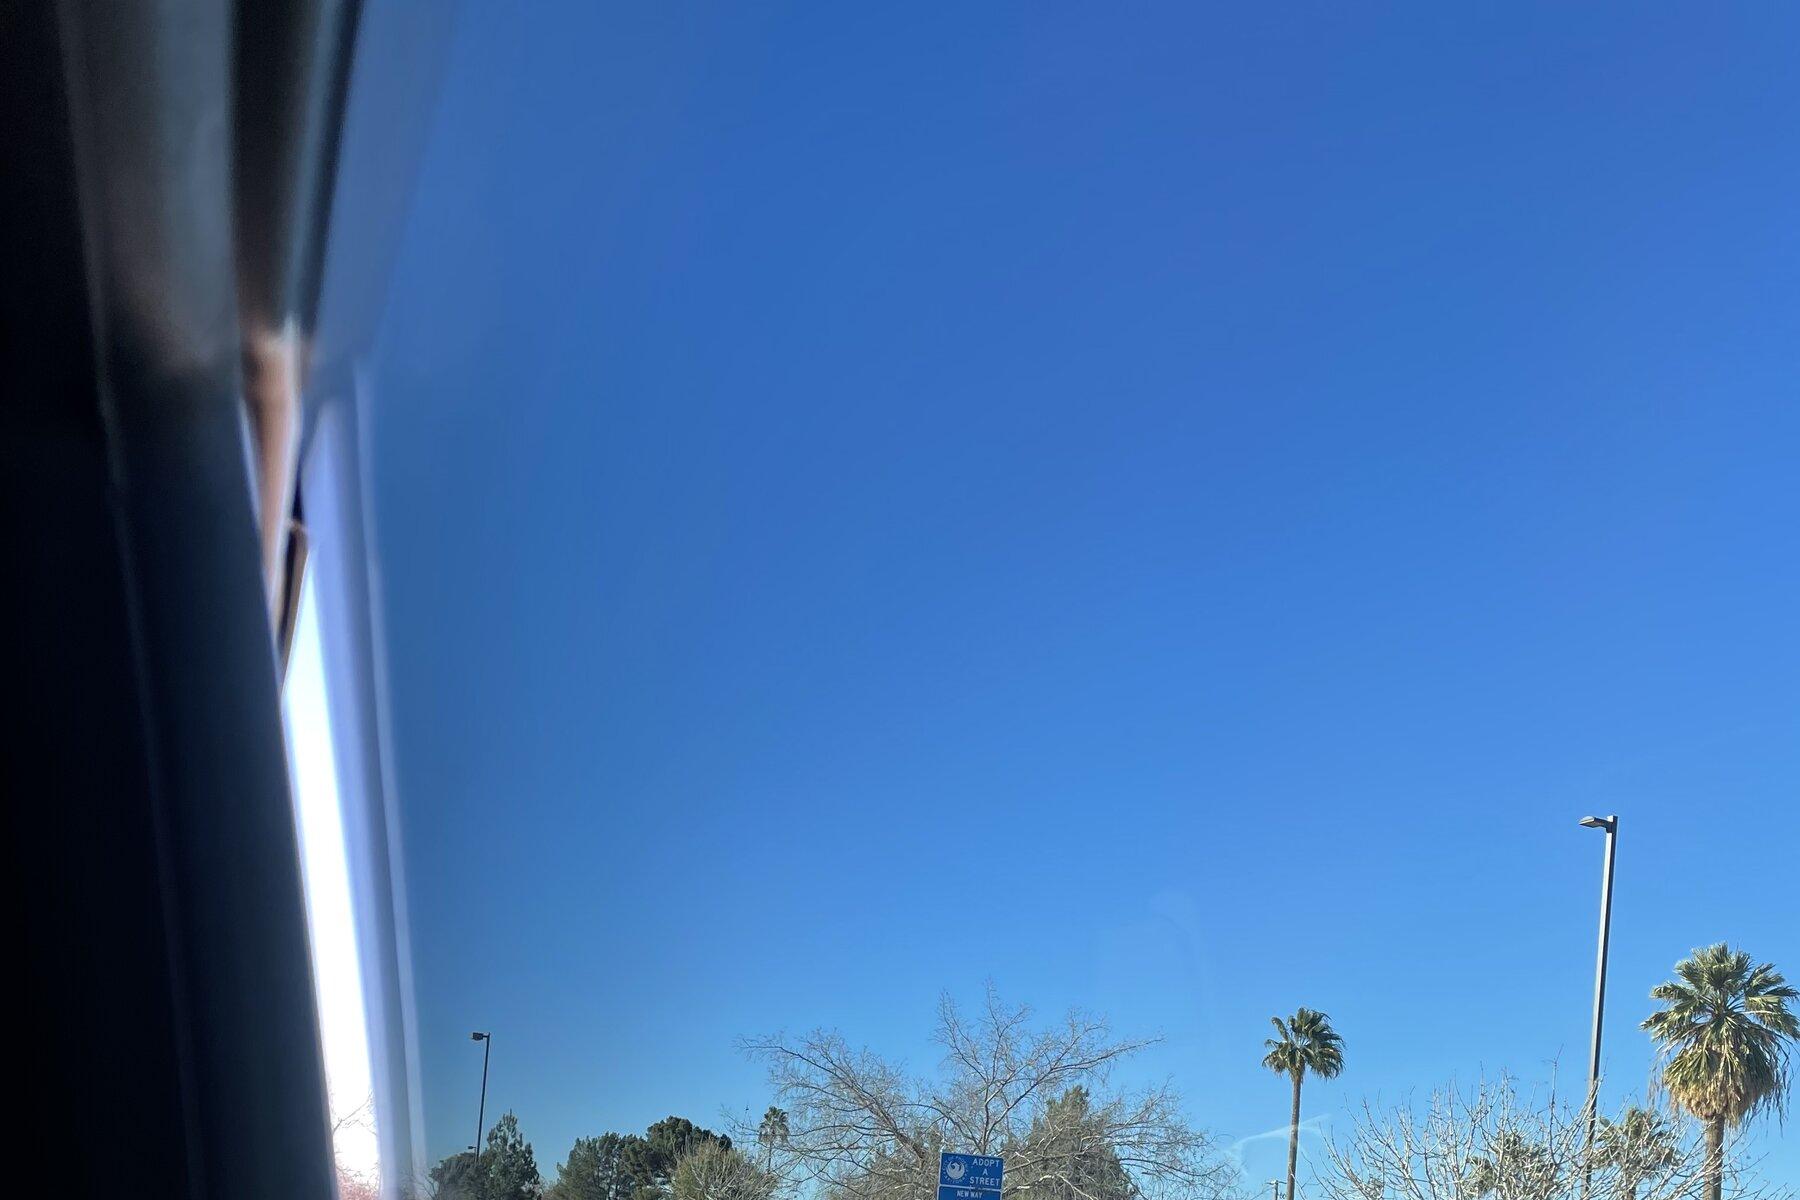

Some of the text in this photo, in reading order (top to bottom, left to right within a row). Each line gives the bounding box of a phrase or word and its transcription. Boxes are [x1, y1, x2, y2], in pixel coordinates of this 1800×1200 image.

[972, 1158, 1000, 1168] ADOPT
[982, 1168, 988, 1176] A
[969, 1176, 1000, 1186] STREET
[956, 1190, 983, 1199] NEW WAY
